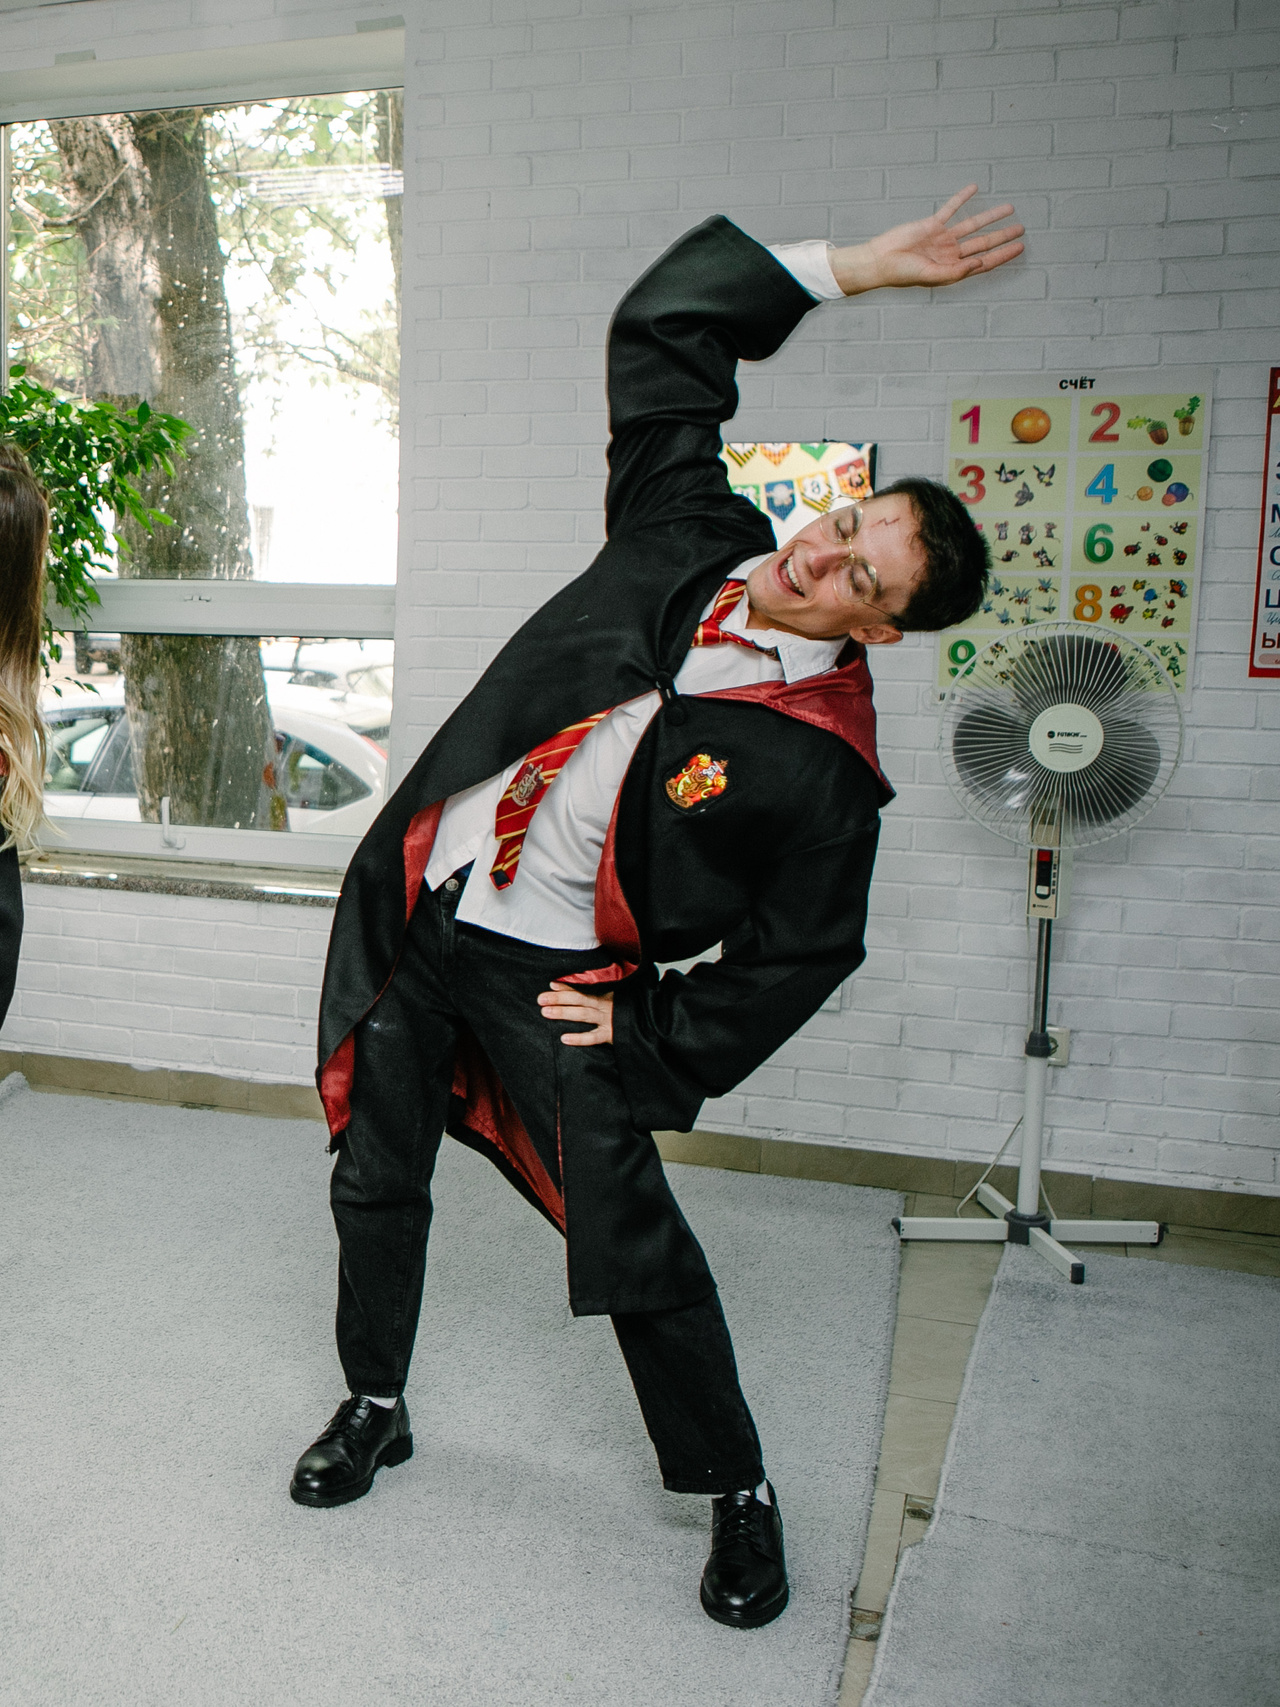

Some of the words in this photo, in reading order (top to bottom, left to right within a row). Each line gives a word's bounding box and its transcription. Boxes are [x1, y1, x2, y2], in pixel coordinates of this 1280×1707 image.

[1059, 375, 1097, 390] СЧЁТ
[959, 404, 981, 444] 1
[1088, 401, 1122, 443] 2
[958, 464, 986, 505] 3
[1085, 463, 1119, 504] 4
[1083, 522, 1115, 565] 6
[1073, 583, 1103, 623] 8
[948, 639, 977, 678] 9
